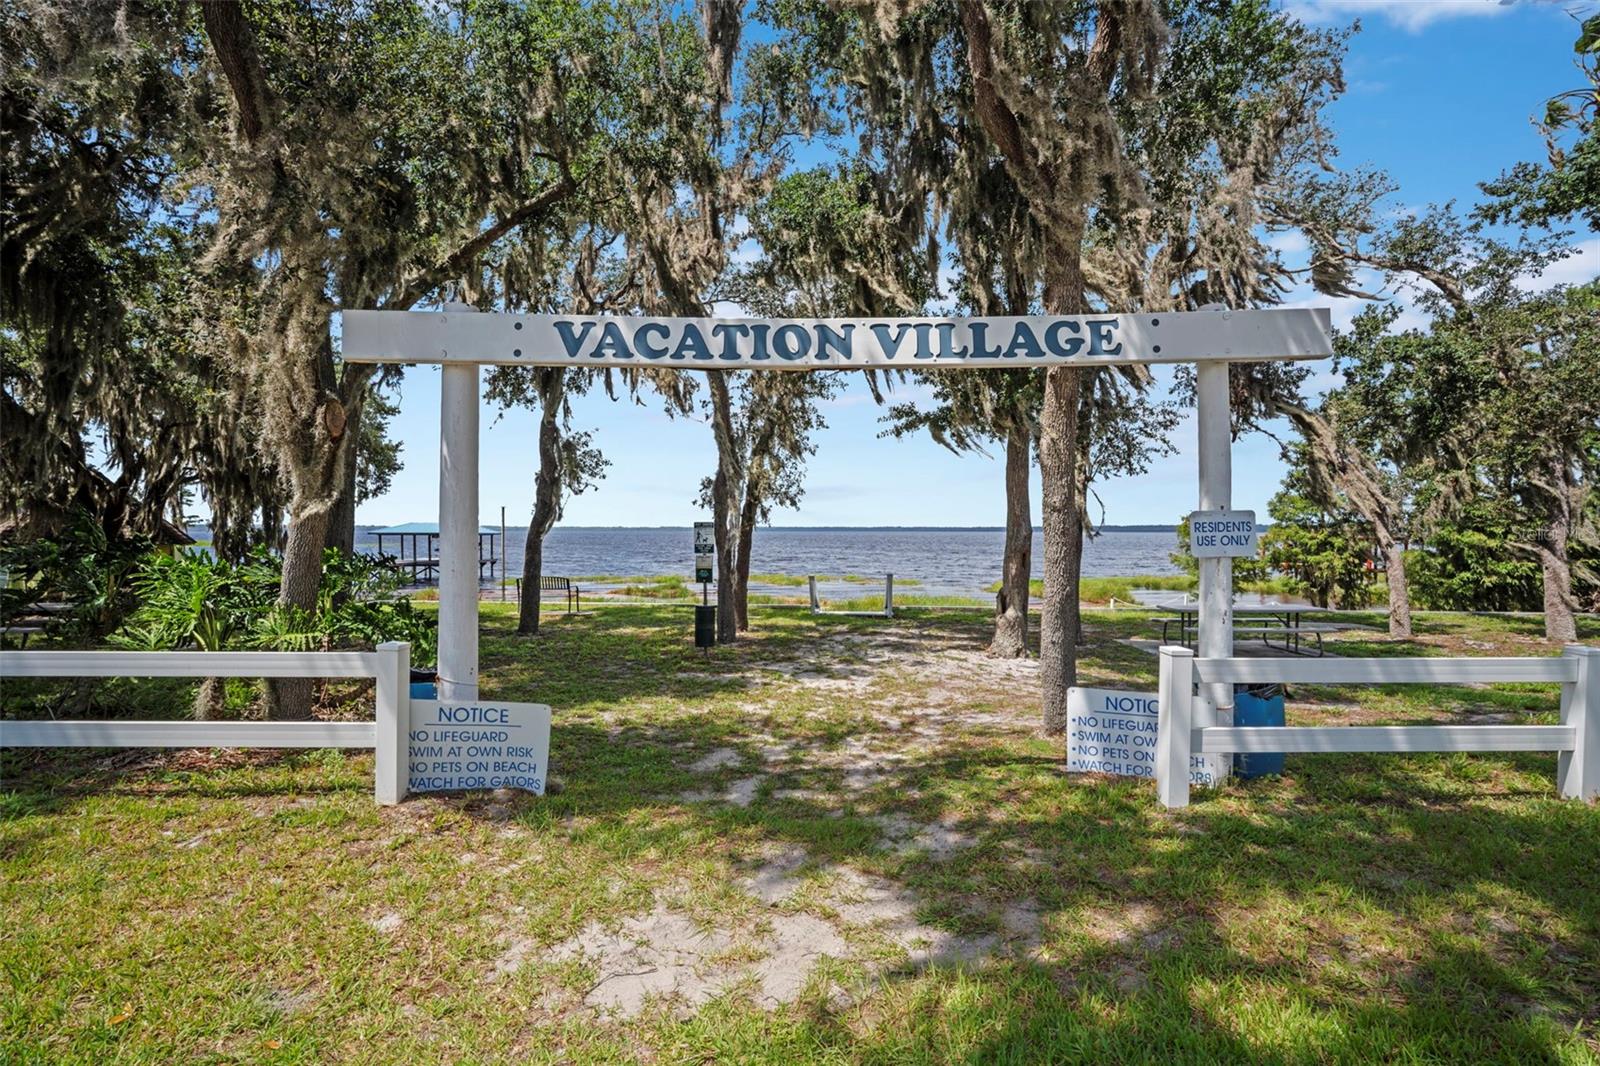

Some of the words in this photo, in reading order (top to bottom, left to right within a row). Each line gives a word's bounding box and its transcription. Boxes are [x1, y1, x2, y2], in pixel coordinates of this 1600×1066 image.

[553, 320, 856, 361] VACATION
[869, 318, 1123, 360] VILLAGE
[1194, 521, 1252, 533] RESIDENTS
[1196, 535, 1217, 547] USE
[1220, 534, 1251, 546] ONLY
[1105, 696, 1159, 715] NOTIC
[438, 707, 509, 723] NOTICE
[1078, 716, 1098, 728] NO
[1102, 718, 1159, 733] LIFEGUA
[433, 730, 509, 742] LIFEGUARD
[1078, 731, 1111, 743] SWIM
[1115, 734, 1128, 745] AT
[1133, 735, 1158, 748] OW
[447, 746, 463, 757] AT
[466, 746, 502, 757] OWN
[506, 746, 534, 758] RISK
[1078, 745, 1098, 756] NO
[1102, 747, 1129, 759] PETS
[1133, 750, 1155, 762] ON
[432, 761, 462, 773] PETS
[466, 761, 489, 772] ON
[493, 762, 537, 774] BEACH
[1078, 759, 1122, 773] WATCH
[1126, 763, 1153, 777] FOR
[457, 776, 486, 787] FOR
[490, 776, 541, 790] GATORS
